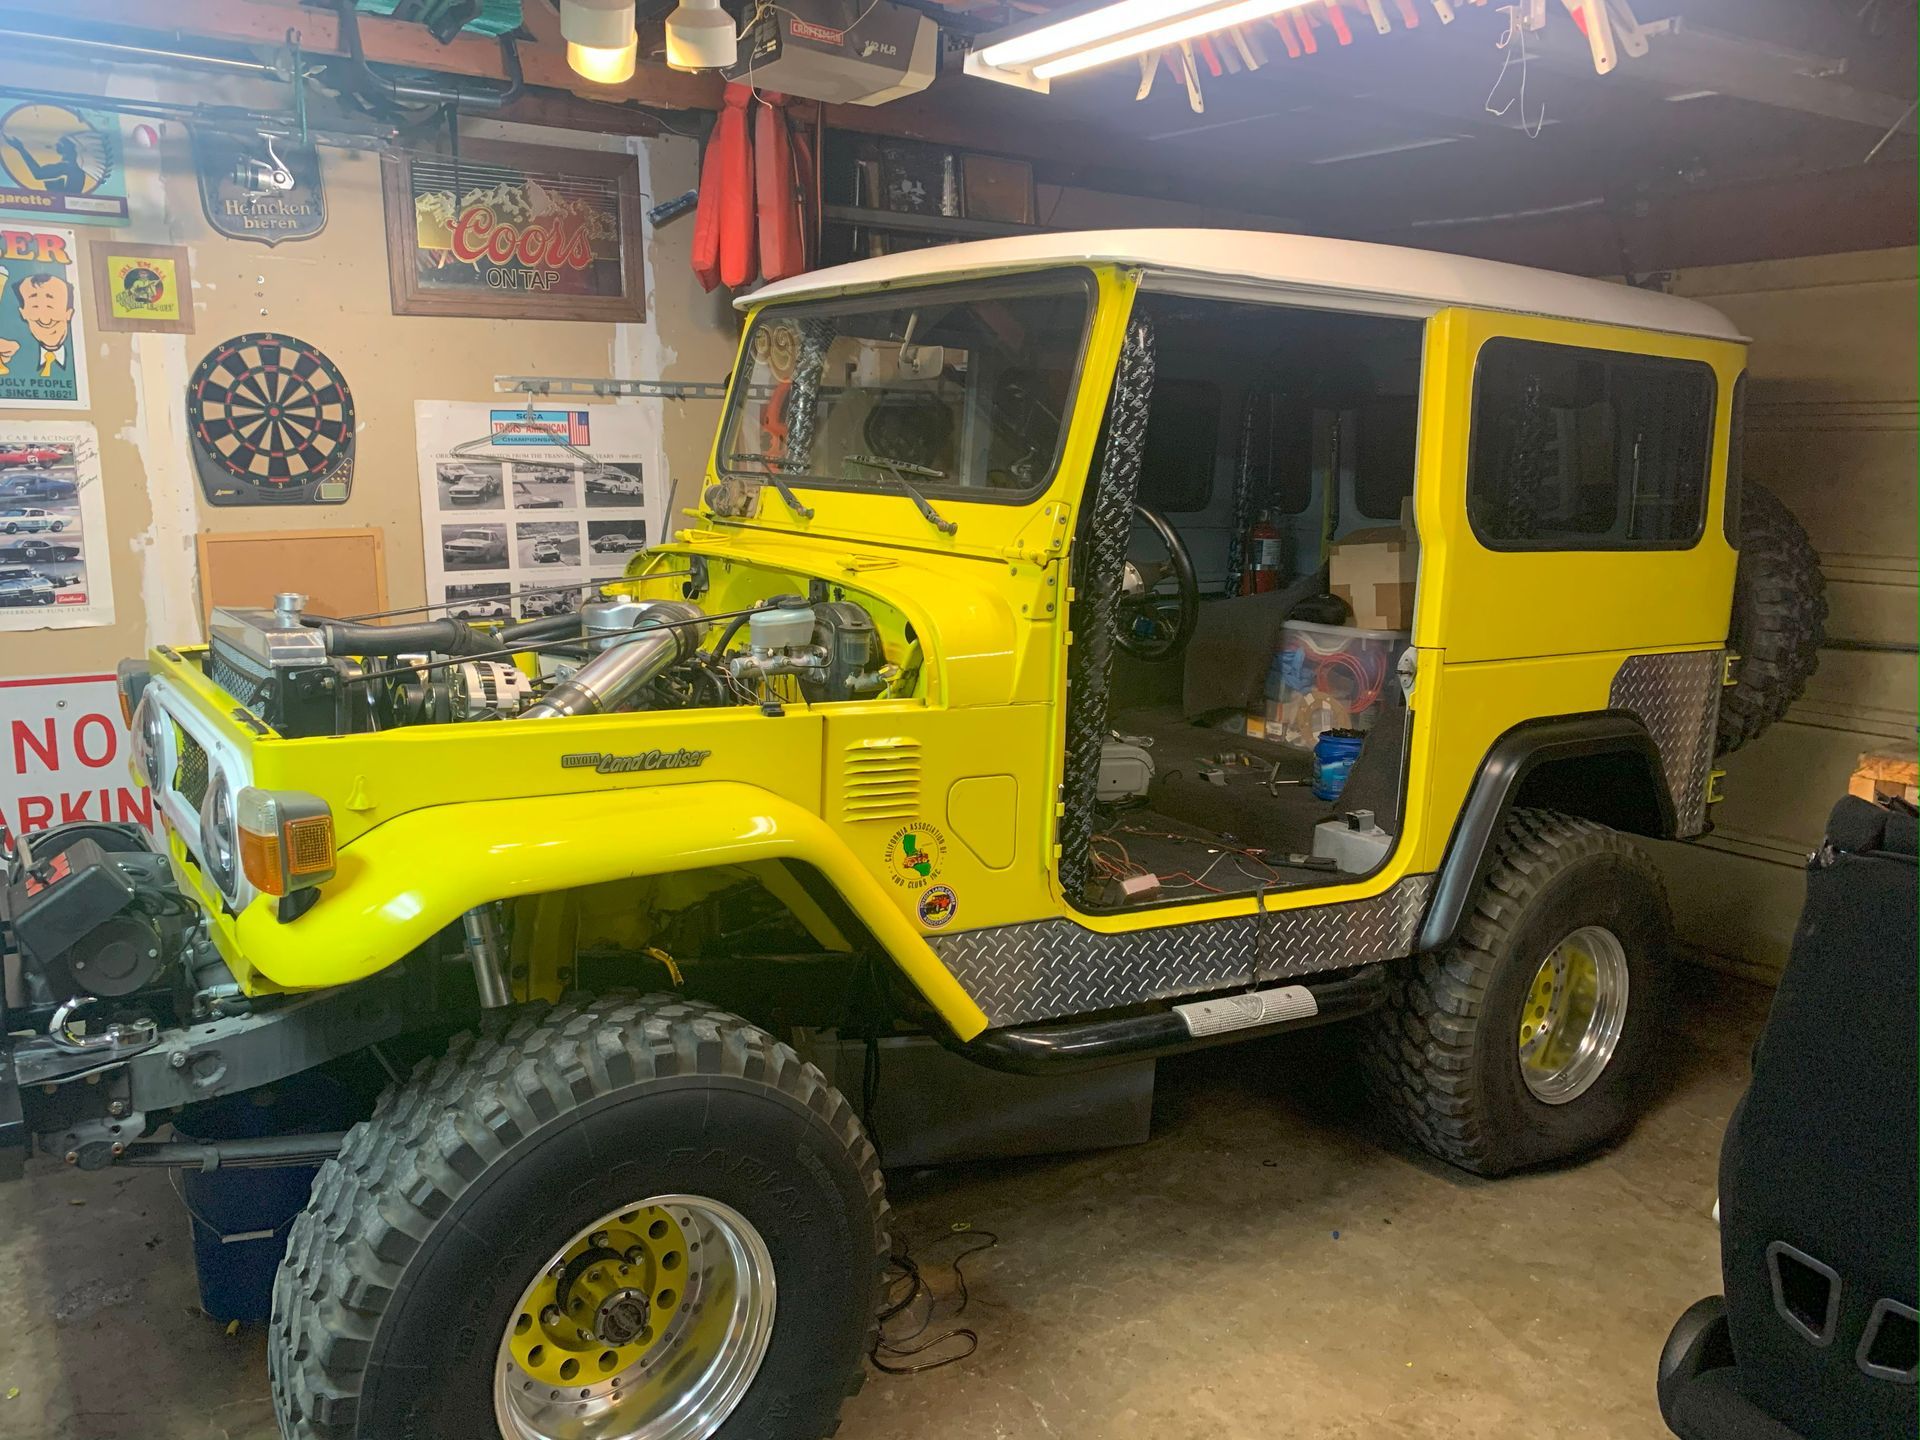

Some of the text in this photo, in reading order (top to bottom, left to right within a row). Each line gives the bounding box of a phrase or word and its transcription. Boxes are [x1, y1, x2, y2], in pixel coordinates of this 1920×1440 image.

[225, 199, 311, 216] Heineken
[243, 216, 298, 229] bieren
[0, 230, 72, 265] ER
[445, 203, 593, 271] Coors
[486, 268, 560, 291] ON TAP
[5, 389, 72, 398] SINCE 1862!
[30, 379, 72, 388] PEOPLE
[12, 713, 117, 774] NO
[564, 749, 711, 773] TOYOTA Land Cruiser
[884, 826, 908, 862] CALIFORNIA
[910, 822, 945, 845] ASSOCIATION
[892, 874, 905, 886] 4WD
[907, 879, 927, 889] CLUBS
